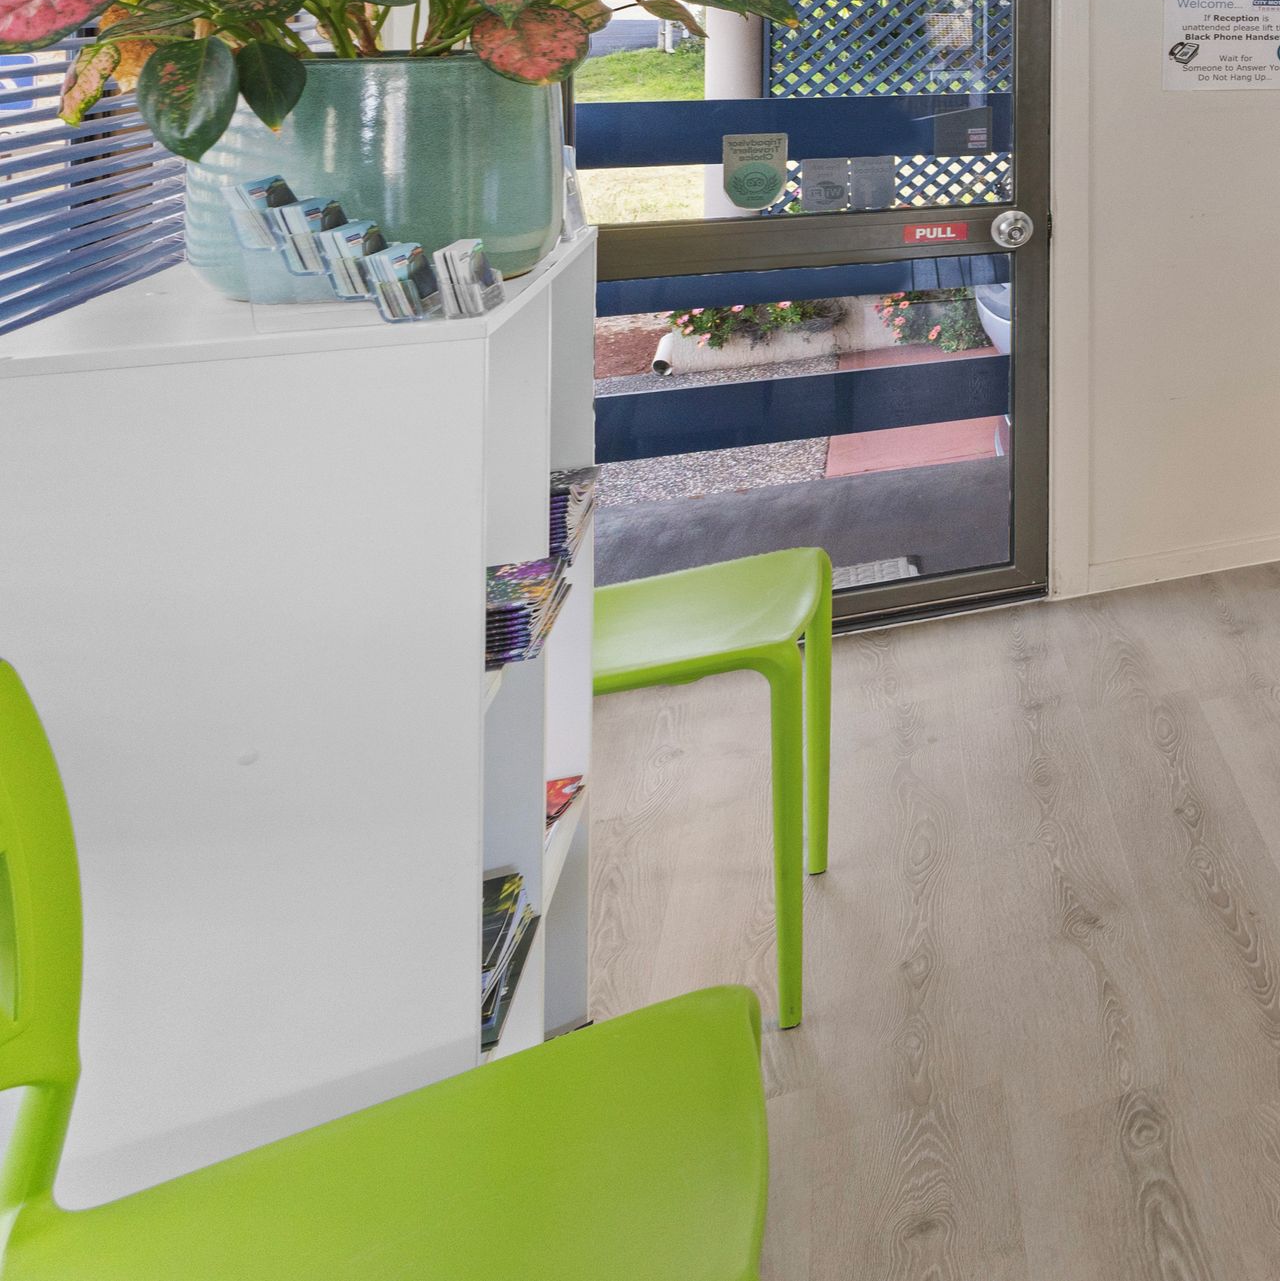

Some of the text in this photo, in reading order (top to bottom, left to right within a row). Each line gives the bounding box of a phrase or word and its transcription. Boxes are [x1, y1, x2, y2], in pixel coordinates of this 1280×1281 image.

[1213, 14, 1270, 23] Reception is
[1182, 24, 1231, 32] unattended
[1233, 24, 1260, 33] please
[1262, 23, 1274, 32] lift
[1185, 33, 1212, 41] Black
[1213, 33, 1243, 41] Phone
[1182, 64, 1223, 72] Someone
[1236, 64, 1267, 72] Answer
[1230, 74, 1253, 83] Hang
[915, 226, 957, 239] PULL
